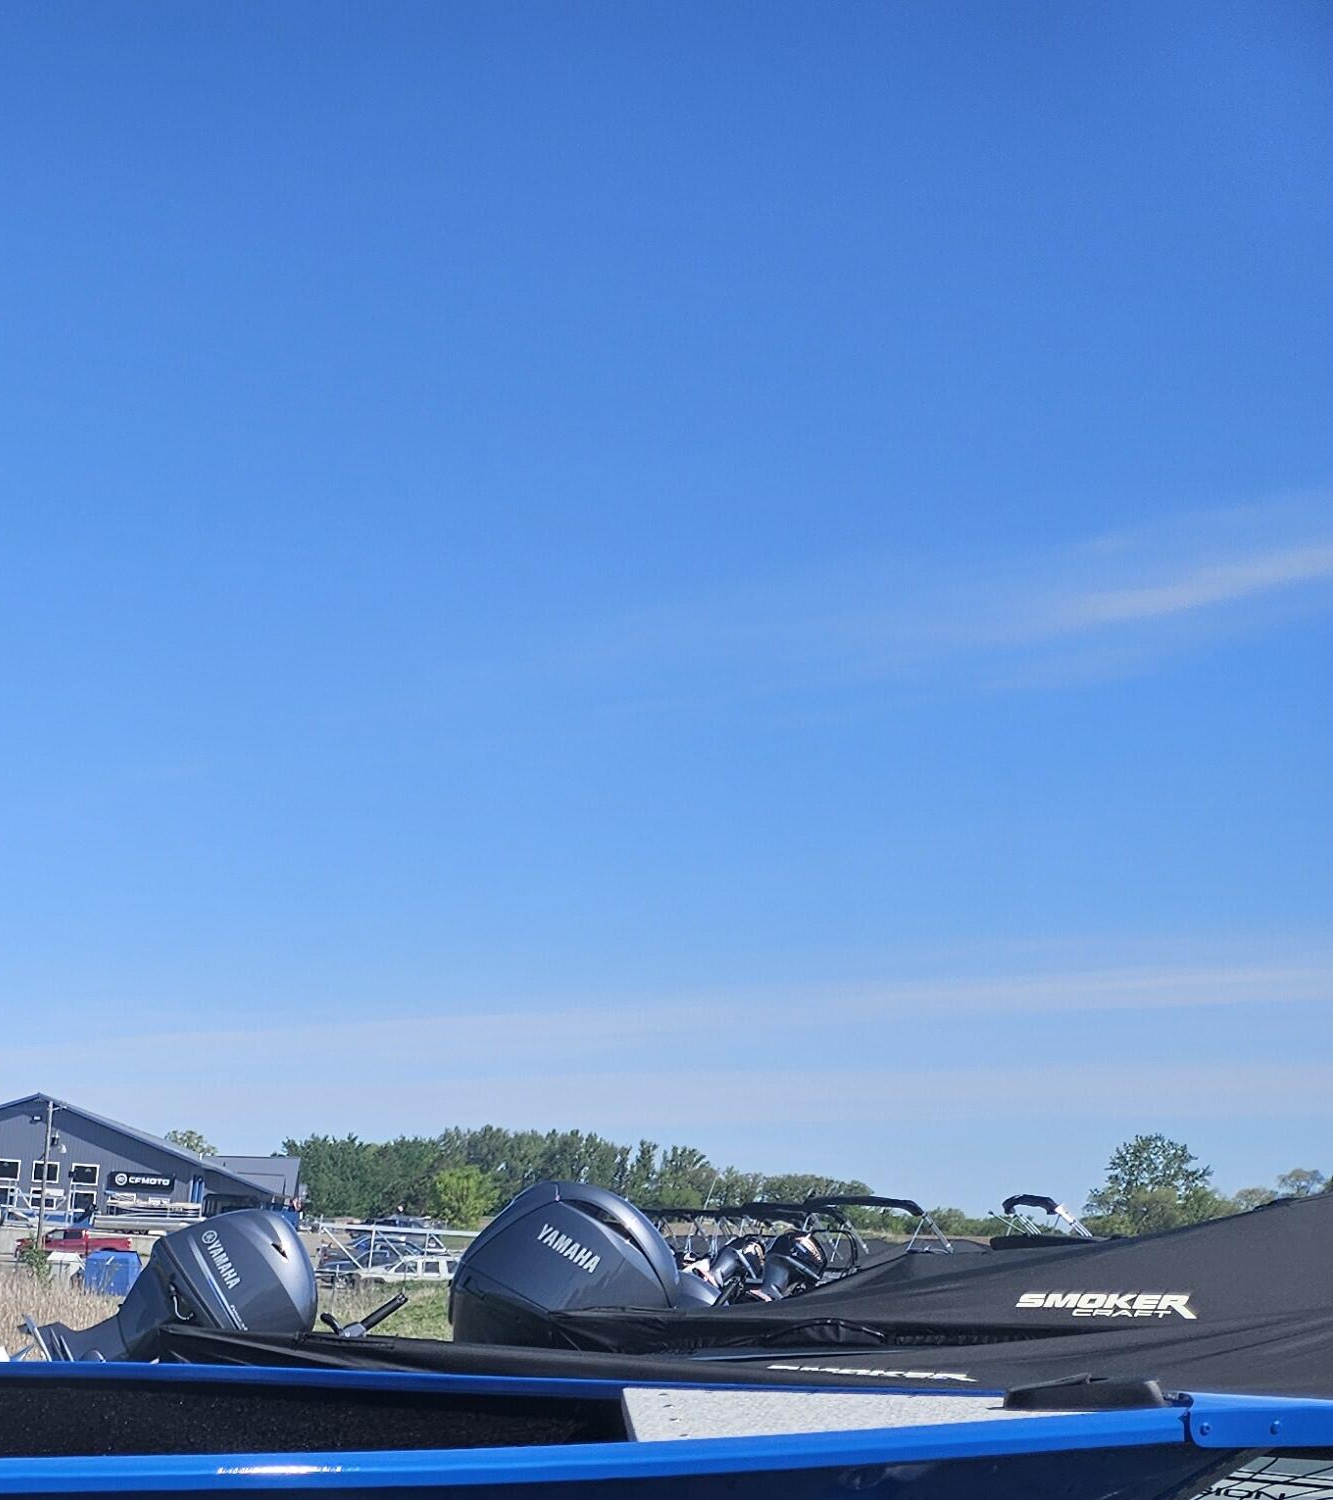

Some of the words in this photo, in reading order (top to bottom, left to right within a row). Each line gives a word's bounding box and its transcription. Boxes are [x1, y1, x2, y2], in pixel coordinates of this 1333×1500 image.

[128, 1176, 170, 1186] CFMOTO
[537, 1223, 601, 1274] YAMAHA
[207, 1240, 241, 1290] YAMAHA
[1015, 1292, 1198, 1320] SMOKER
[1071, 1308, 1172, 1319] CRAFT
